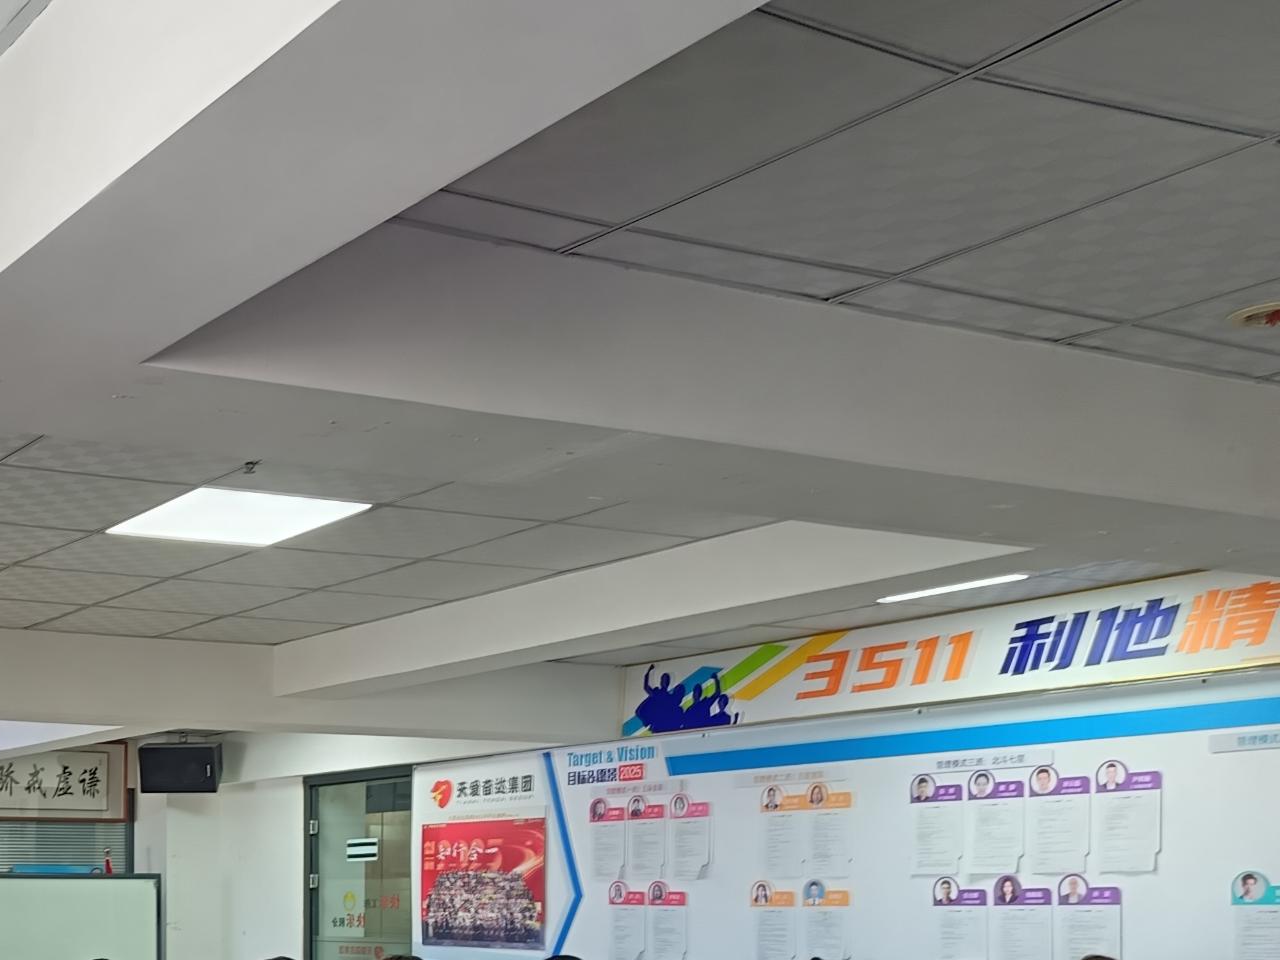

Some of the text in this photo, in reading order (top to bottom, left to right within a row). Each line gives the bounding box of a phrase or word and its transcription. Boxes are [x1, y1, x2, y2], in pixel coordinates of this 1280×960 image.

[795, 631, 975, 700] 3511
[567, 745, 655, 767] Target & Vision
